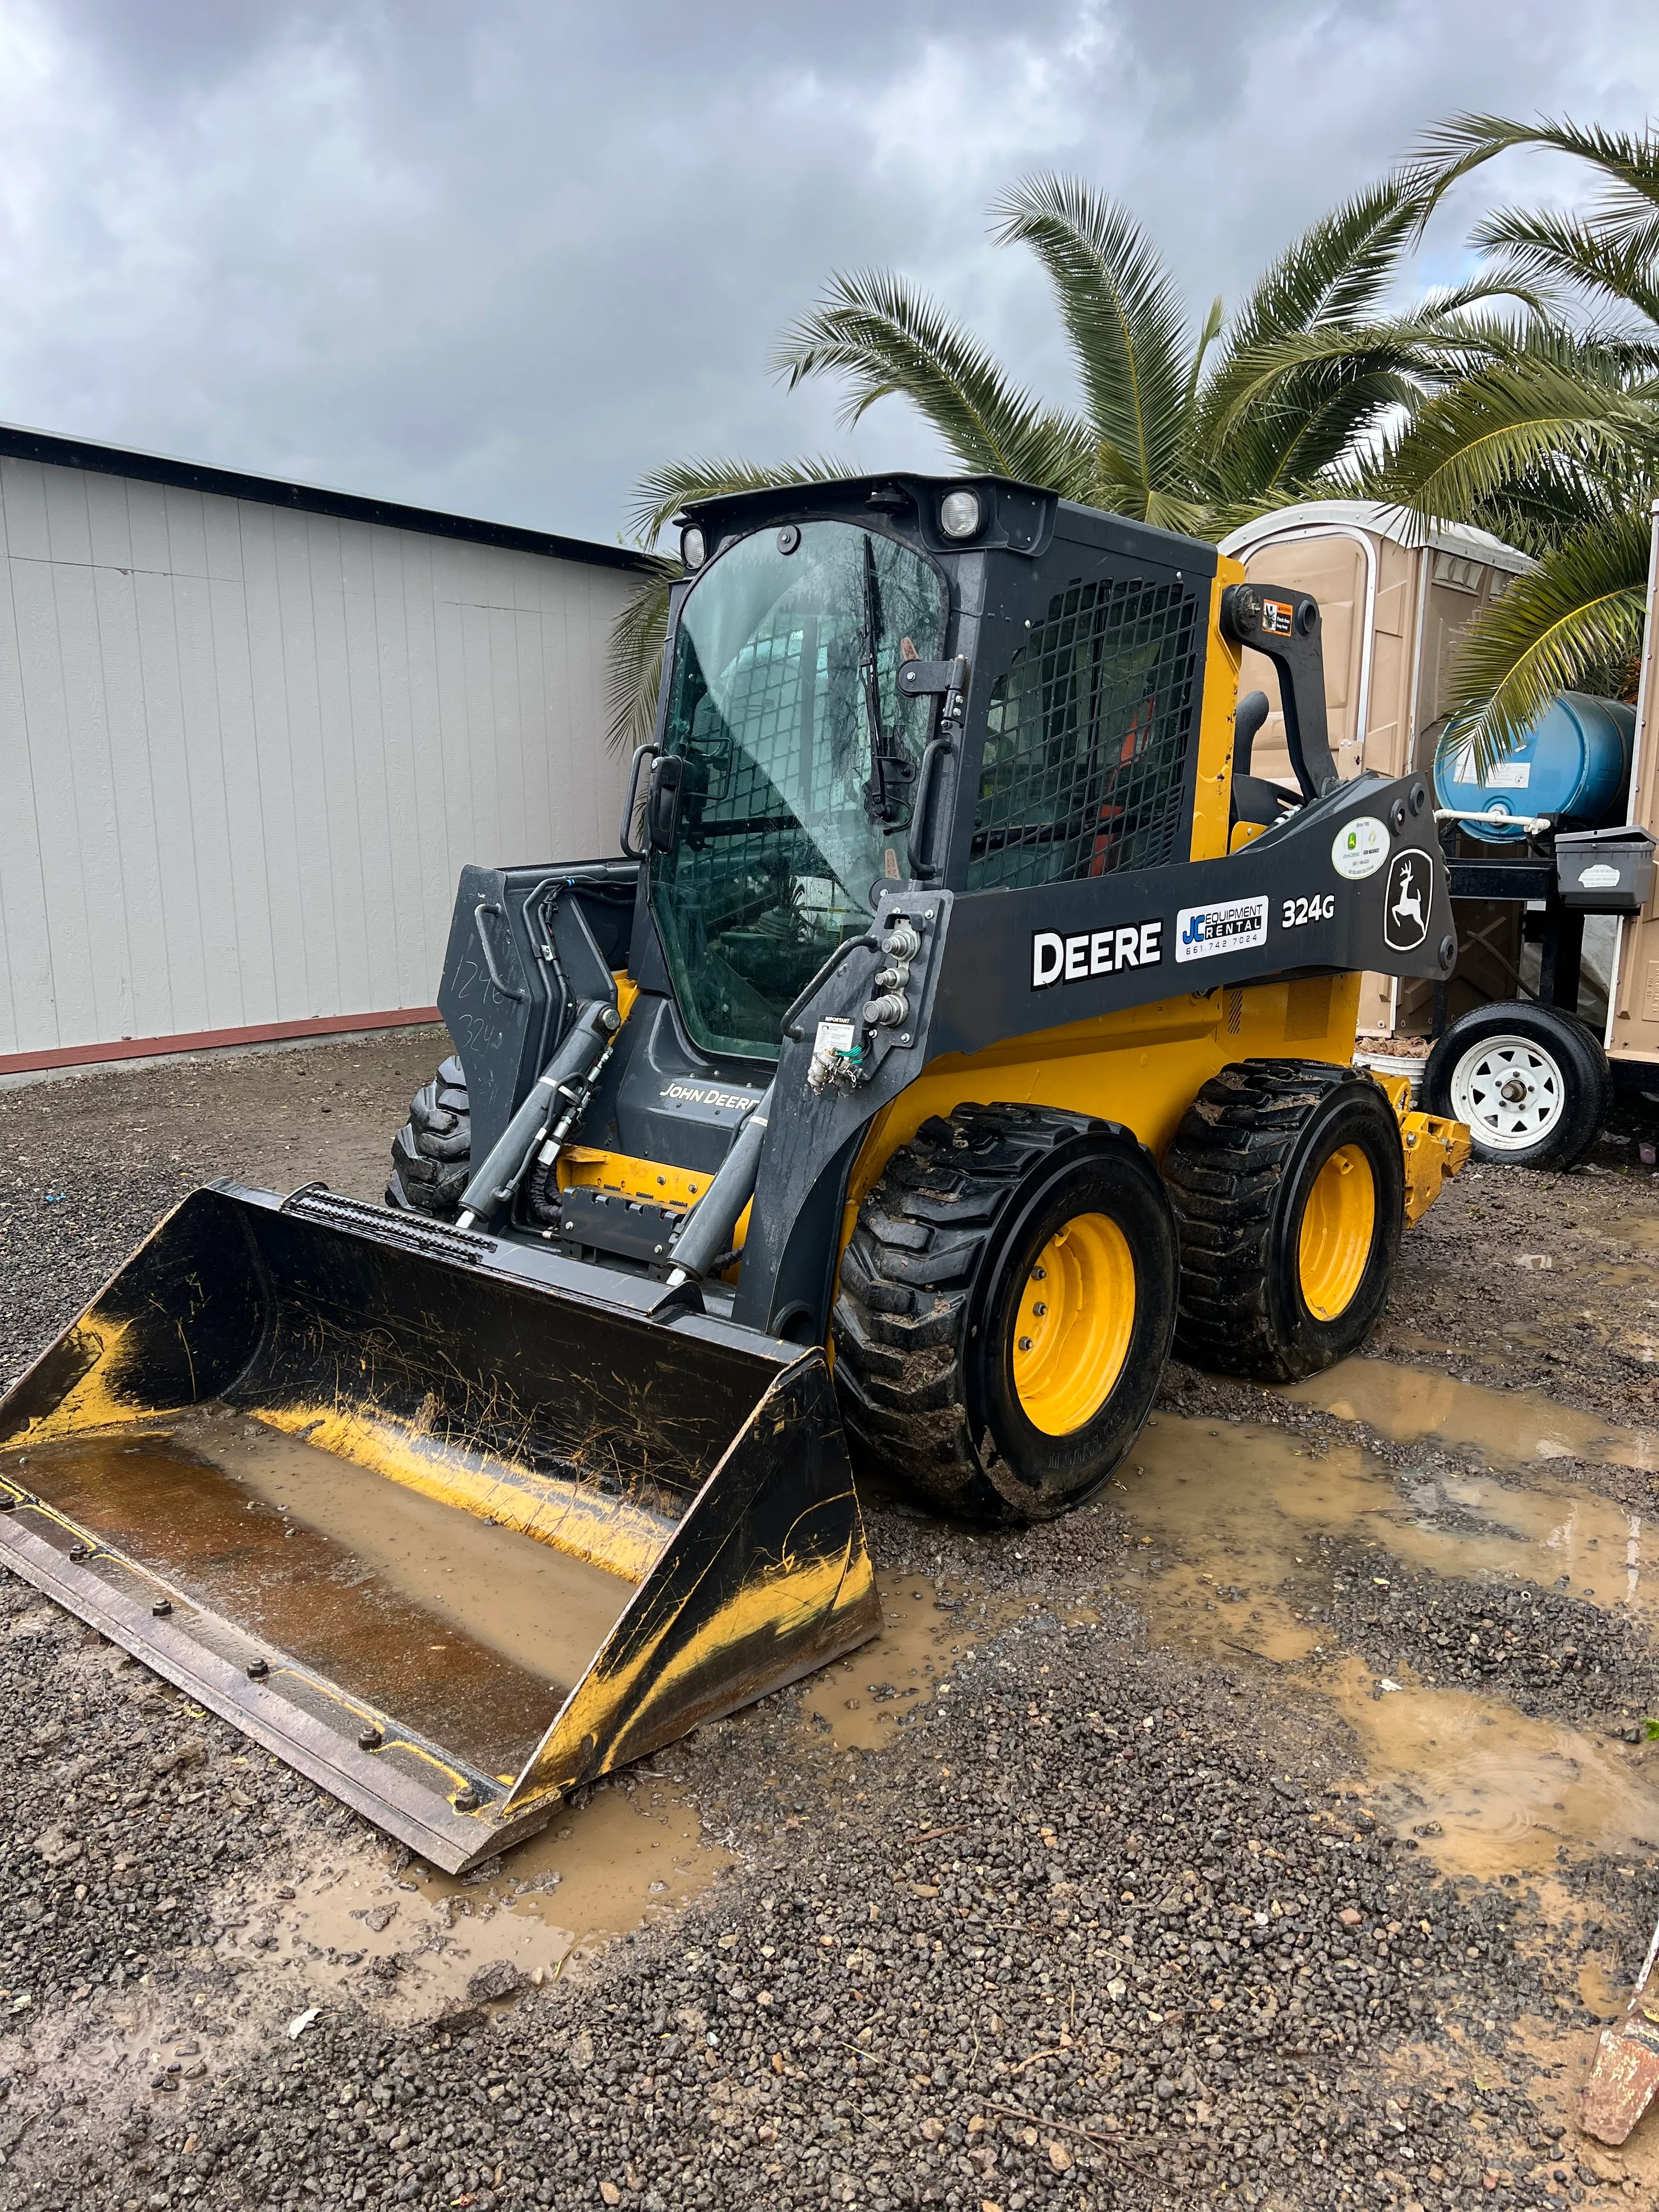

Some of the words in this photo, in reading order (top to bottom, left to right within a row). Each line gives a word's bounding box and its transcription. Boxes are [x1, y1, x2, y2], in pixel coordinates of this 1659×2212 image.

[1182, 914, 1205, 944] JC
[1205, 904, 1262, 924] EQUIPMENT
[1282, 894, 1335, 928] 324G
[1186, 934, 1257, 955] 661.742.7024
[1206, 918, 1260, 939] RENTAL
[1034, 922, 1161, 986] DEERE
[459, 1014, 495, 1054] 324
[658, 1082, 705, 1102] JOHN
[1064, 1435, 1102, 1468] 2000
